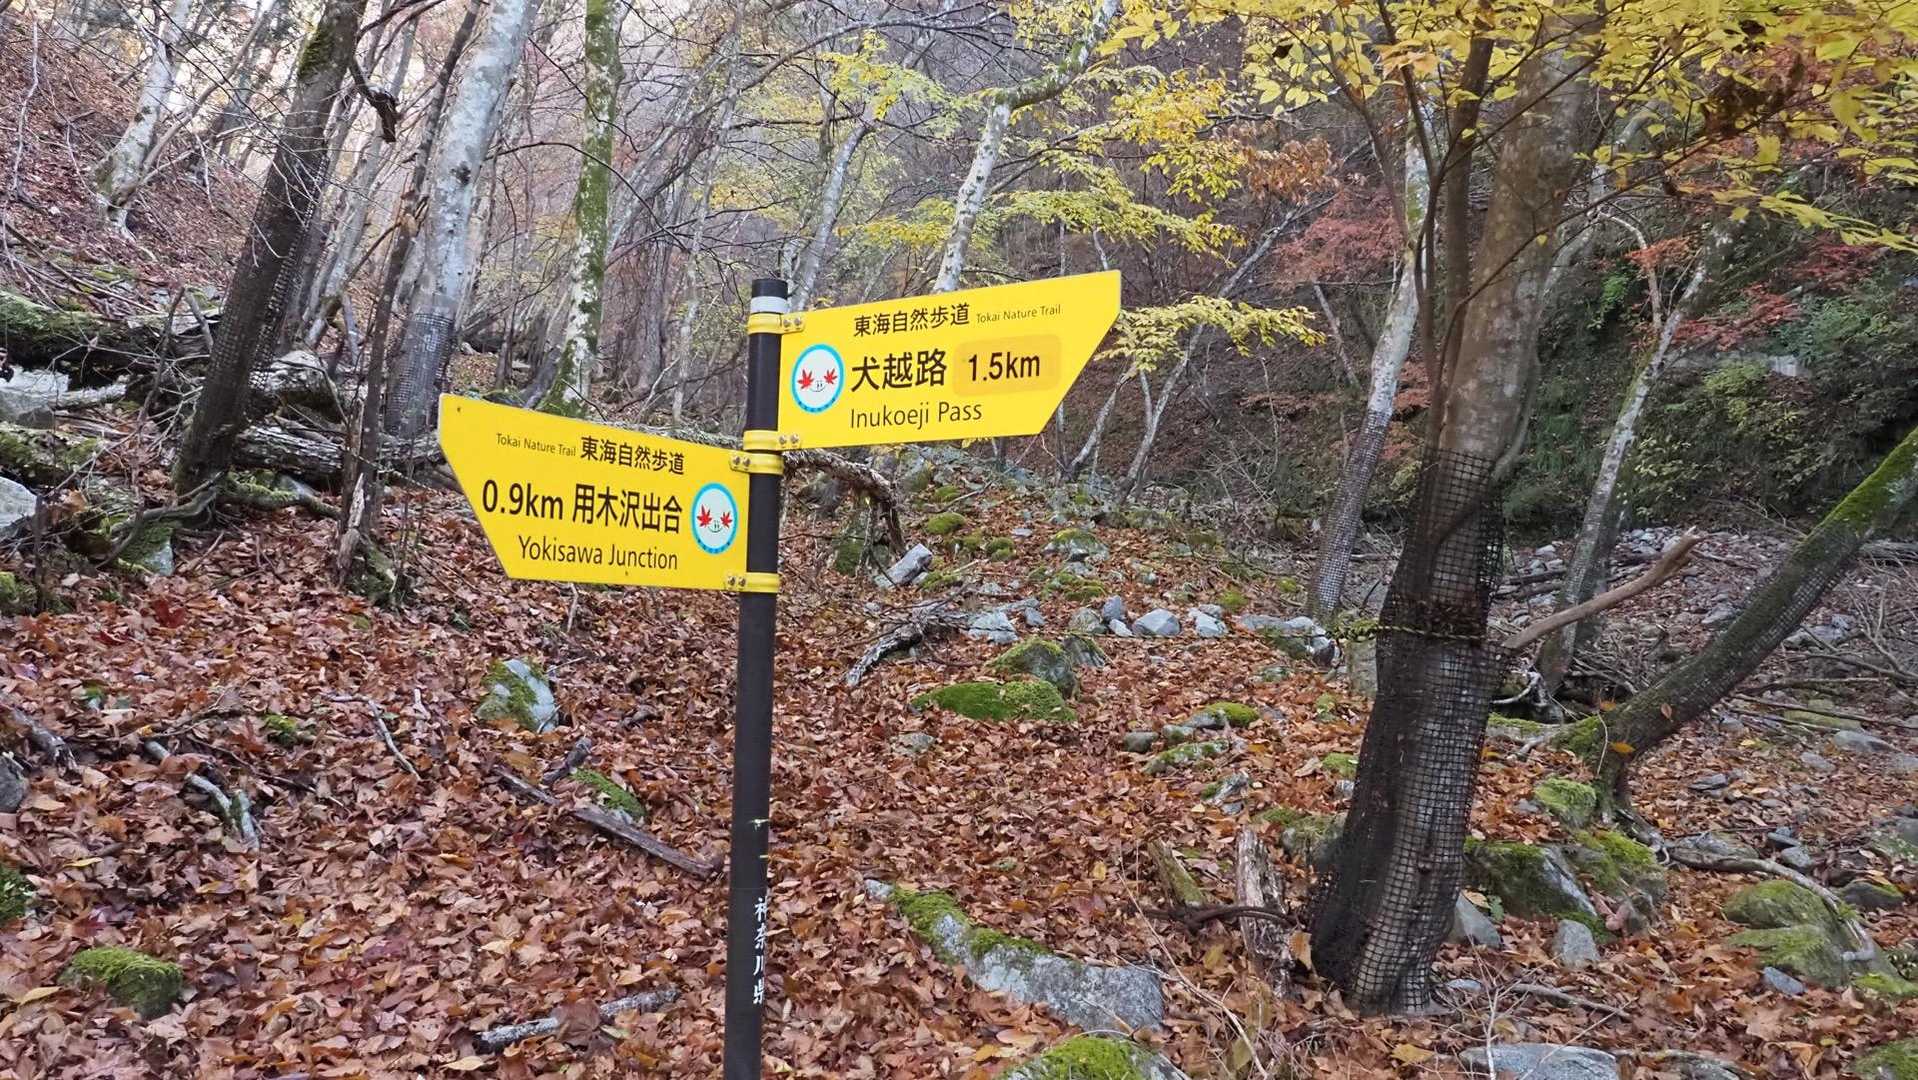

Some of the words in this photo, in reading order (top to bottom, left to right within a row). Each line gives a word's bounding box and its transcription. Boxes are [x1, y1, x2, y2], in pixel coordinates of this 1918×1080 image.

[853, 302, 970, 337] 東海自然歩道
[976, 312, 1001, 323] Tokai
[1003, 309, 1038, 321] Nature
[1041, 304, 1061, 316] Trail
[851, 348, 948, 393] 犬越路
[968, 351, 1041, 382] 1.5km
[850, 402, 929, 429] Inukoeji
[938, 401, 982, 423] Pass
[496, 433, 521, 448] Tokai
[524, 438, 556, 454] Nature
[558, 444, 577, 457] Trail
[580, 435, 685, 475] 東海自然歩道
[482, 479, 564, 520] 0.9km
[572, 483, 683, 535] 用木沢出合
[518, 535, 603, 565] Yokisawa
[608, 543, 678, 570] Junction
